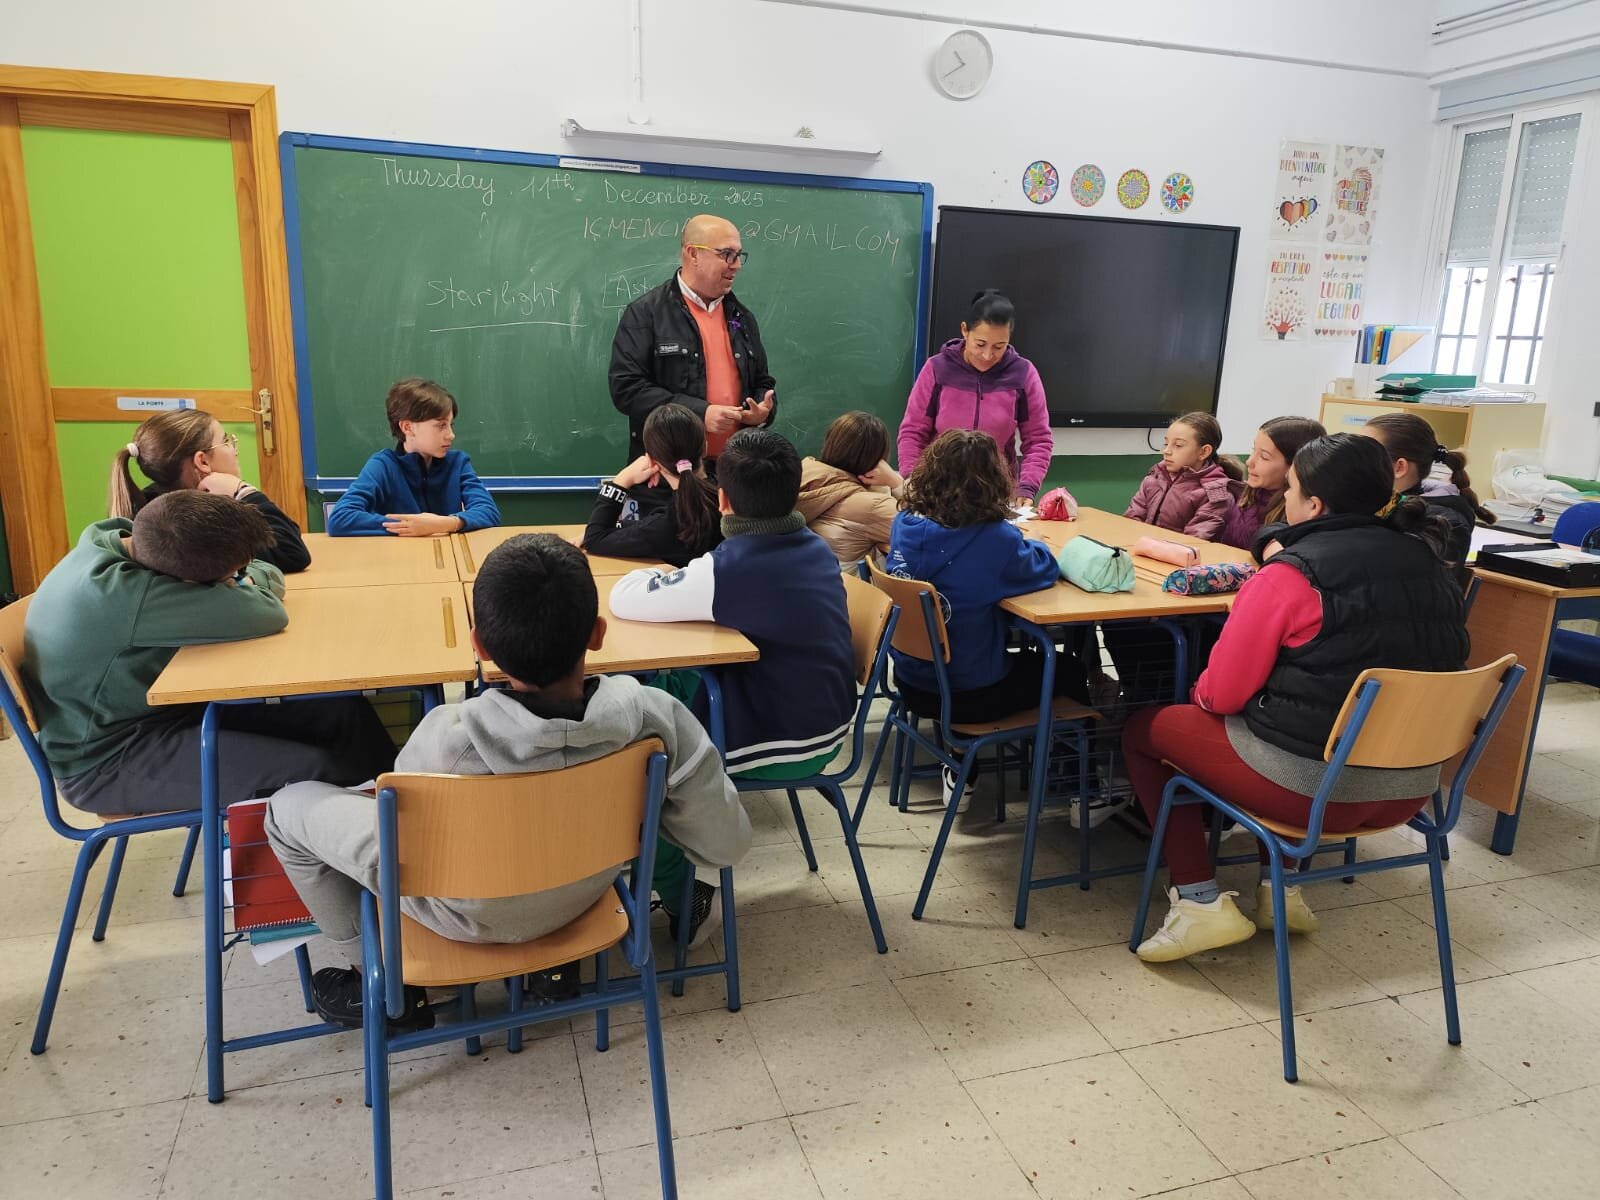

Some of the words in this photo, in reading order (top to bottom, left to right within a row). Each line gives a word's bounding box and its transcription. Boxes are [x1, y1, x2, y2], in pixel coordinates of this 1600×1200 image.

[373, 157, 496, 206] Thursday
[603, 179, 711, 205] December
[616, 273, 652, 300] Ast
[1319, 281, 1361, 300] LUGAR
[1317, 303, 1360, 319] SEGURO
